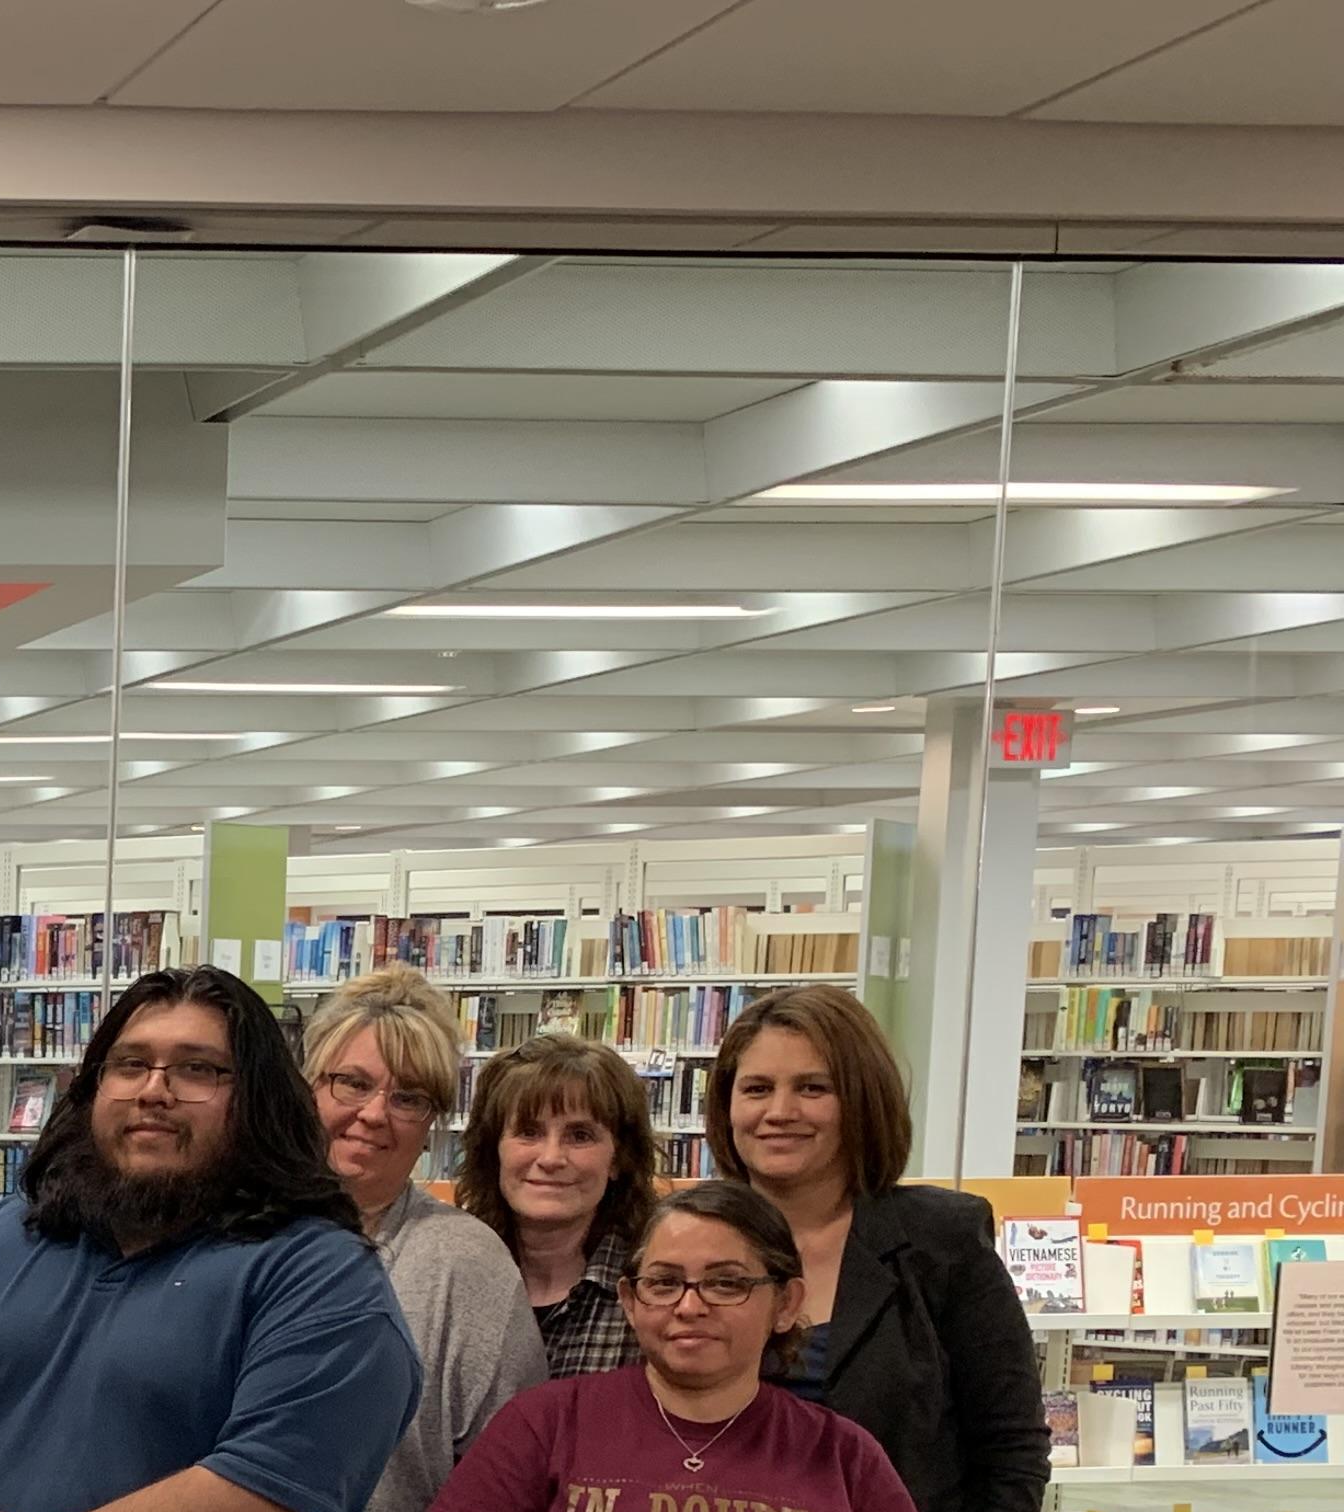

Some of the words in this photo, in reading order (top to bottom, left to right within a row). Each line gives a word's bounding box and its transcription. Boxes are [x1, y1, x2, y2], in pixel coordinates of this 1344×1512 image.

[1003, 714, 1062, 761] EXIT
[1121, 1196, 1222, 1225] Running
[1227, 1194, 1273, 1219] and
[1009, 1248, 1078, 1261] VIETNAMESE
[1190, 1386, 1244, 1398] Running
[1190, 1400, 1214, 1411] Past
[1218, 1400, 1244, 1412] Fifty
[1267, 1421, 1315, 1434] RUNNER
[664, 1482, 718, 1494] WHEN
